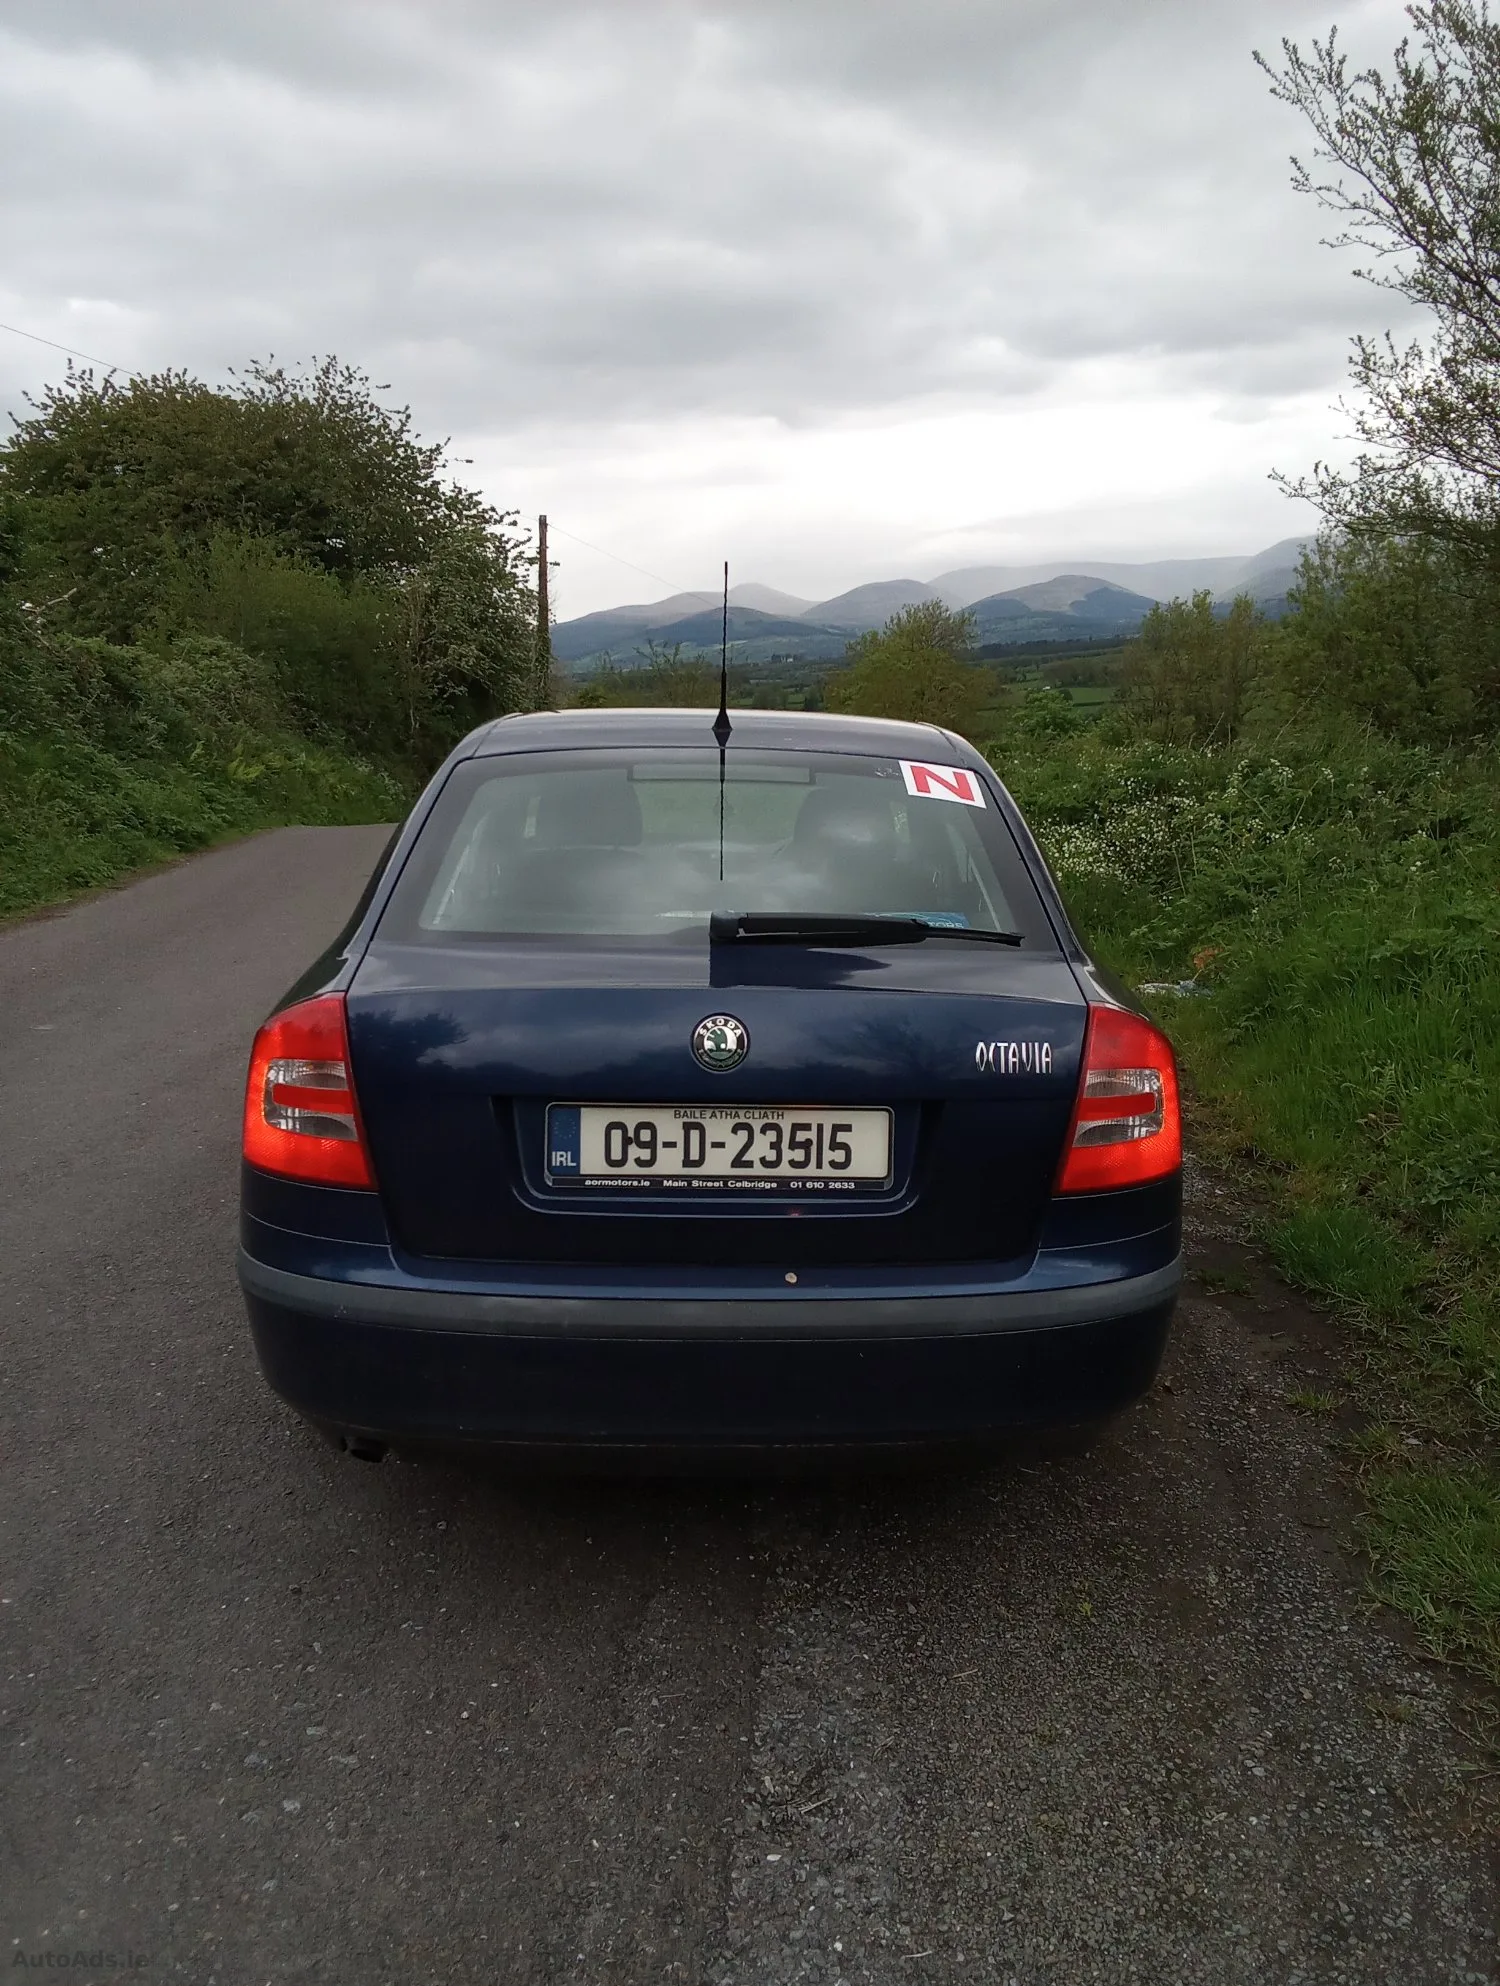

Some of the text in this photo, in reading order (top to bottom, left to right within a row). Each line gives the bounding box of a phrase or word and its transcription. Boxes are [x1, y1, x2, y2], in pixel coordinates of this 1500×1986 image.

[910, 765, 975, 801] N
[975, 1041, 1052, 1074] OCTAVIA
[673, 1109, 785, 1120] BAILE ATHA CLIATH
[604, 1121, 853, 1171] 09-D-23515
[551, 1151, 577, 1167] IRL
[584, 1178, 856, 1190] aormotors.ie Main Street Celbridge 01 610 2633
